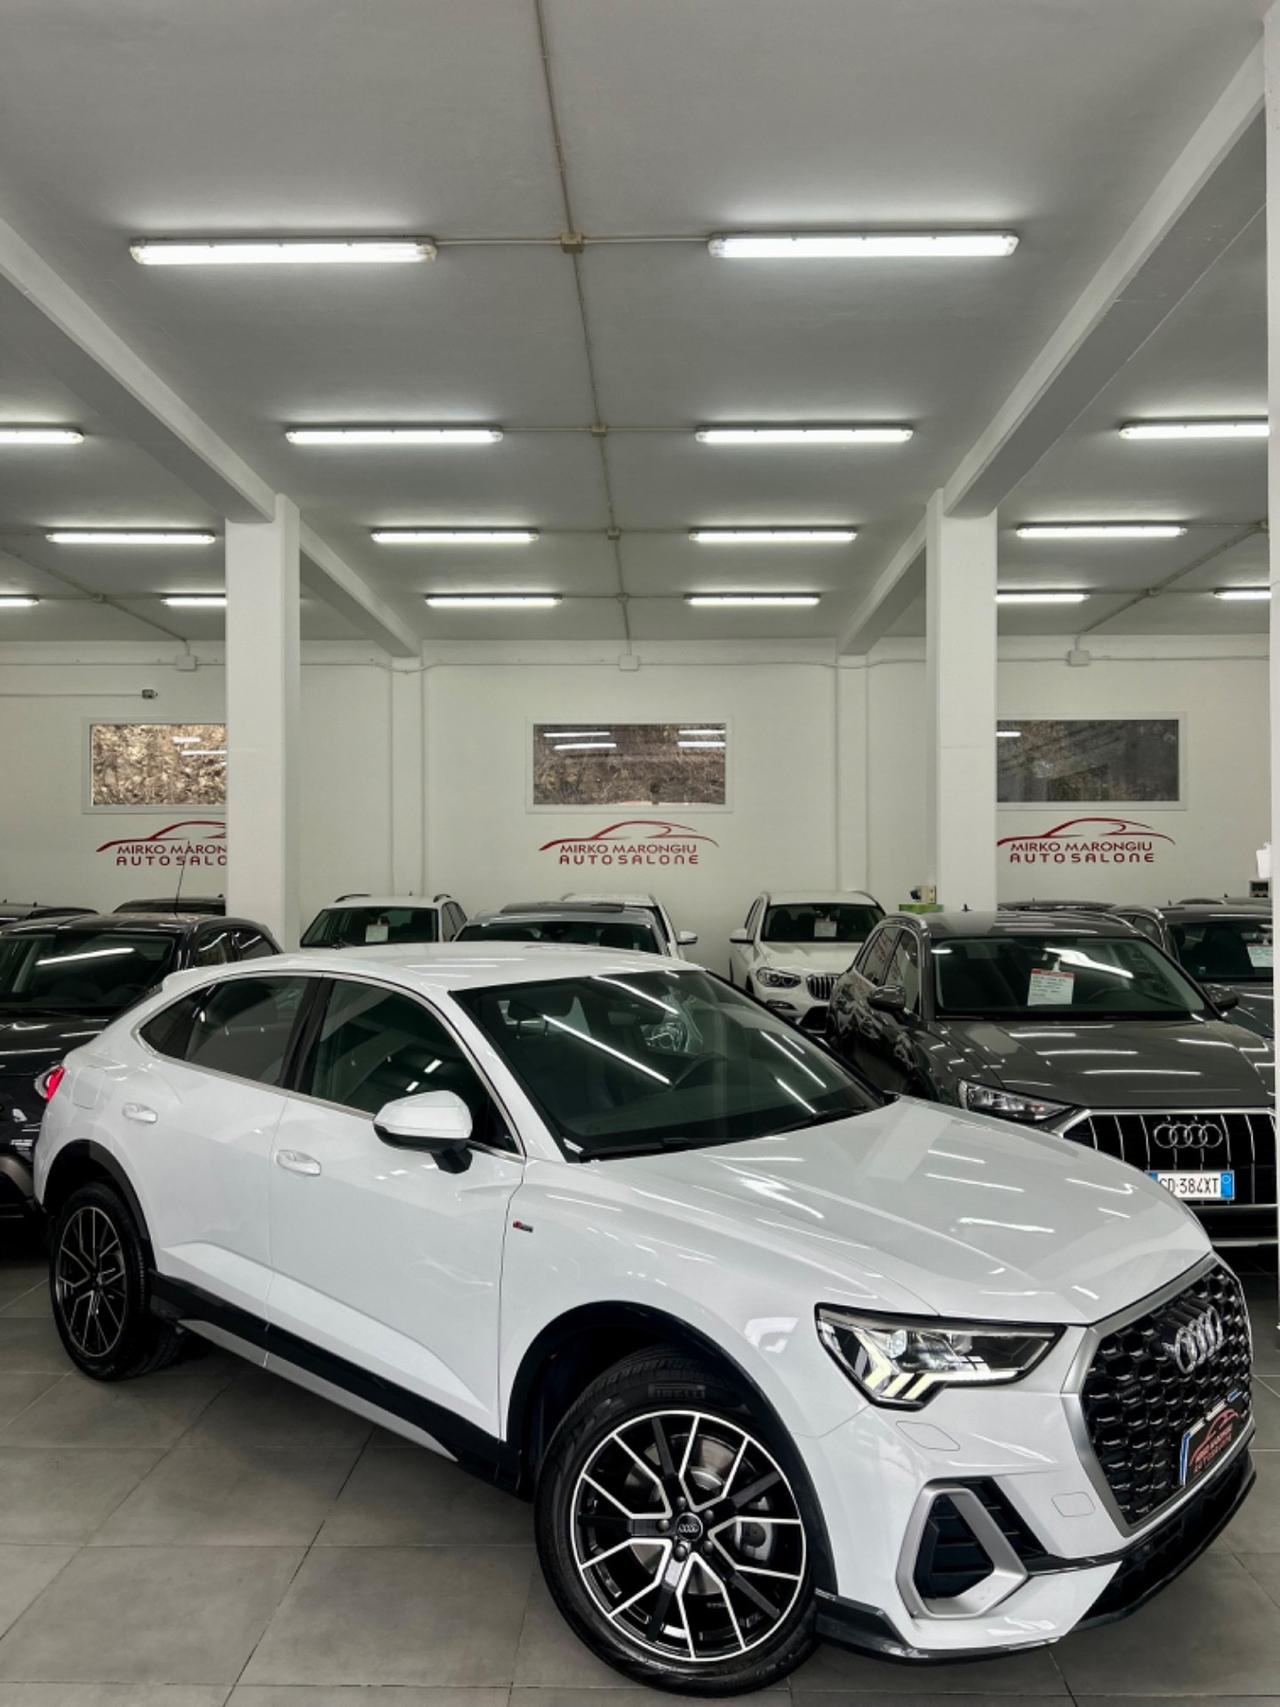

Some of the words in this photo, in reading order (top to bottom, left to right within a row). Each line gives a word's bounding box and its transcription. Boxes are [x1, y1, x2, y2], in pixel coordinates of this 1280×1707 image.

[117, 844, 166, 854] MIRKO
[170, 844, 227, 854] MARON
[560, 844, 609, 854] MIRKO
[613, 844, 697, 854] MARONGIU
[1010, 841, 1061, 851] MIRKO
[1065, 841, 1152, 851] MARONGIU
[116, 856, 227, 866] AUTOSALO
[559, 855, 699, 865] AUTOSALONE
[1009, 852, 1154, 863] AUTOSALONE
